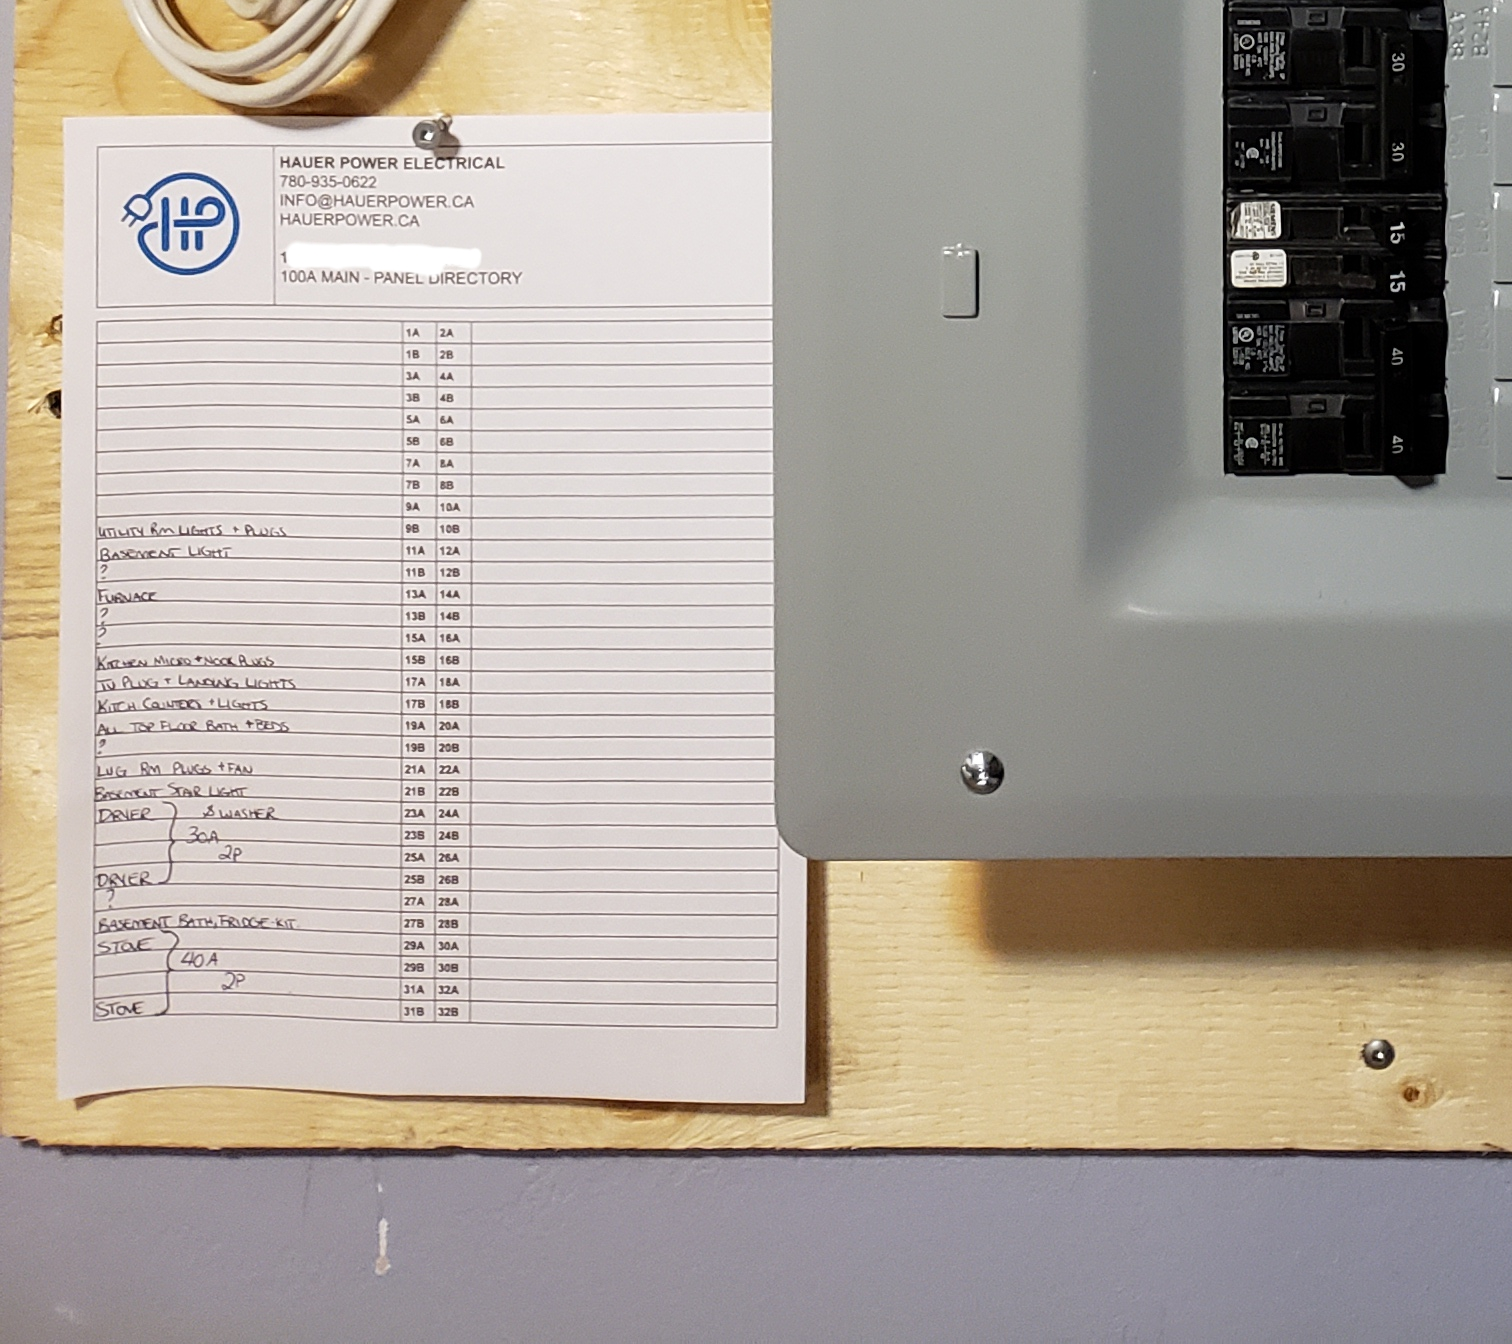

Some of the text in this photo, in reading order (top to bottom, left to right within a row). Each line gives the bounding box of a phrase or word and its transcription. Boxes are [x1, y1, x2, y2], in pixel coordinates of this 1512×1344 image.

[1392, 53, 1405, 71] 30
[281, 157, 505, 169] HAUER POWER ELECTRICAL
[280, 175, 376, 188] 780-935-0622
[280, 194, 474, 210] INFO@HAUERPOWER.CA
[280, 213, 420, 227] HAUERPOWER.CA
[1390, 222, 1405, 243] 15
[282, 270, 317, 283] 100A
[322, 271, 359, 283] MAIN
[374, 272, 424, 284] PANEL
[406, 328, 454, 337] 1A 2A
[1393, 436, 1403, 453] 40
[186, 826, 219, 844] 30A
[219, 845, 242, 862] 2P
[221, 972, 245, 990] 2P
[404, 1007, 458, 1016] 31B 32B
